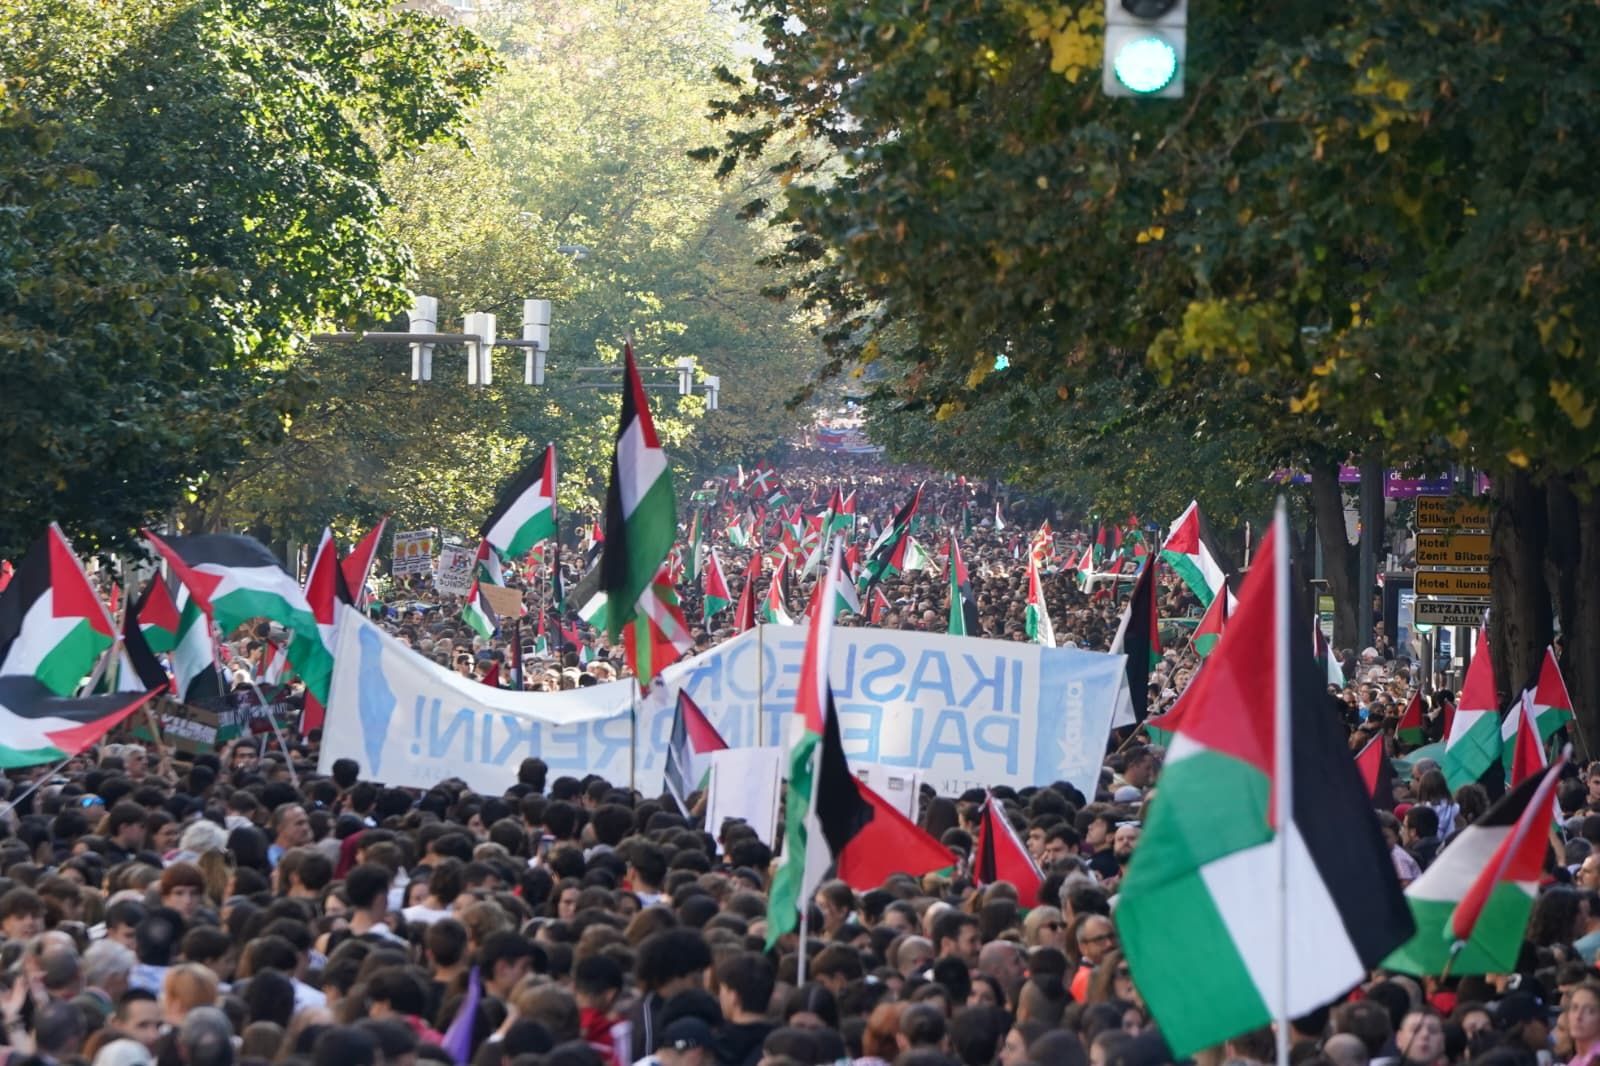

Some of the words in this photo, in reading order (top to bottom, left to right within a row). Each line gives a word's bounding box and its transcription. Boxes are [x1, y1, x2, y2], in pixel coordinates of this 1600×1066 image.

[1419, 539, 1449, 548] Hotel
[1419, 551, 1448, 561] Zenit
[1419, 579, 1449, 589] Hotel
[1443, 615, 1481, 623] POLIZIA
